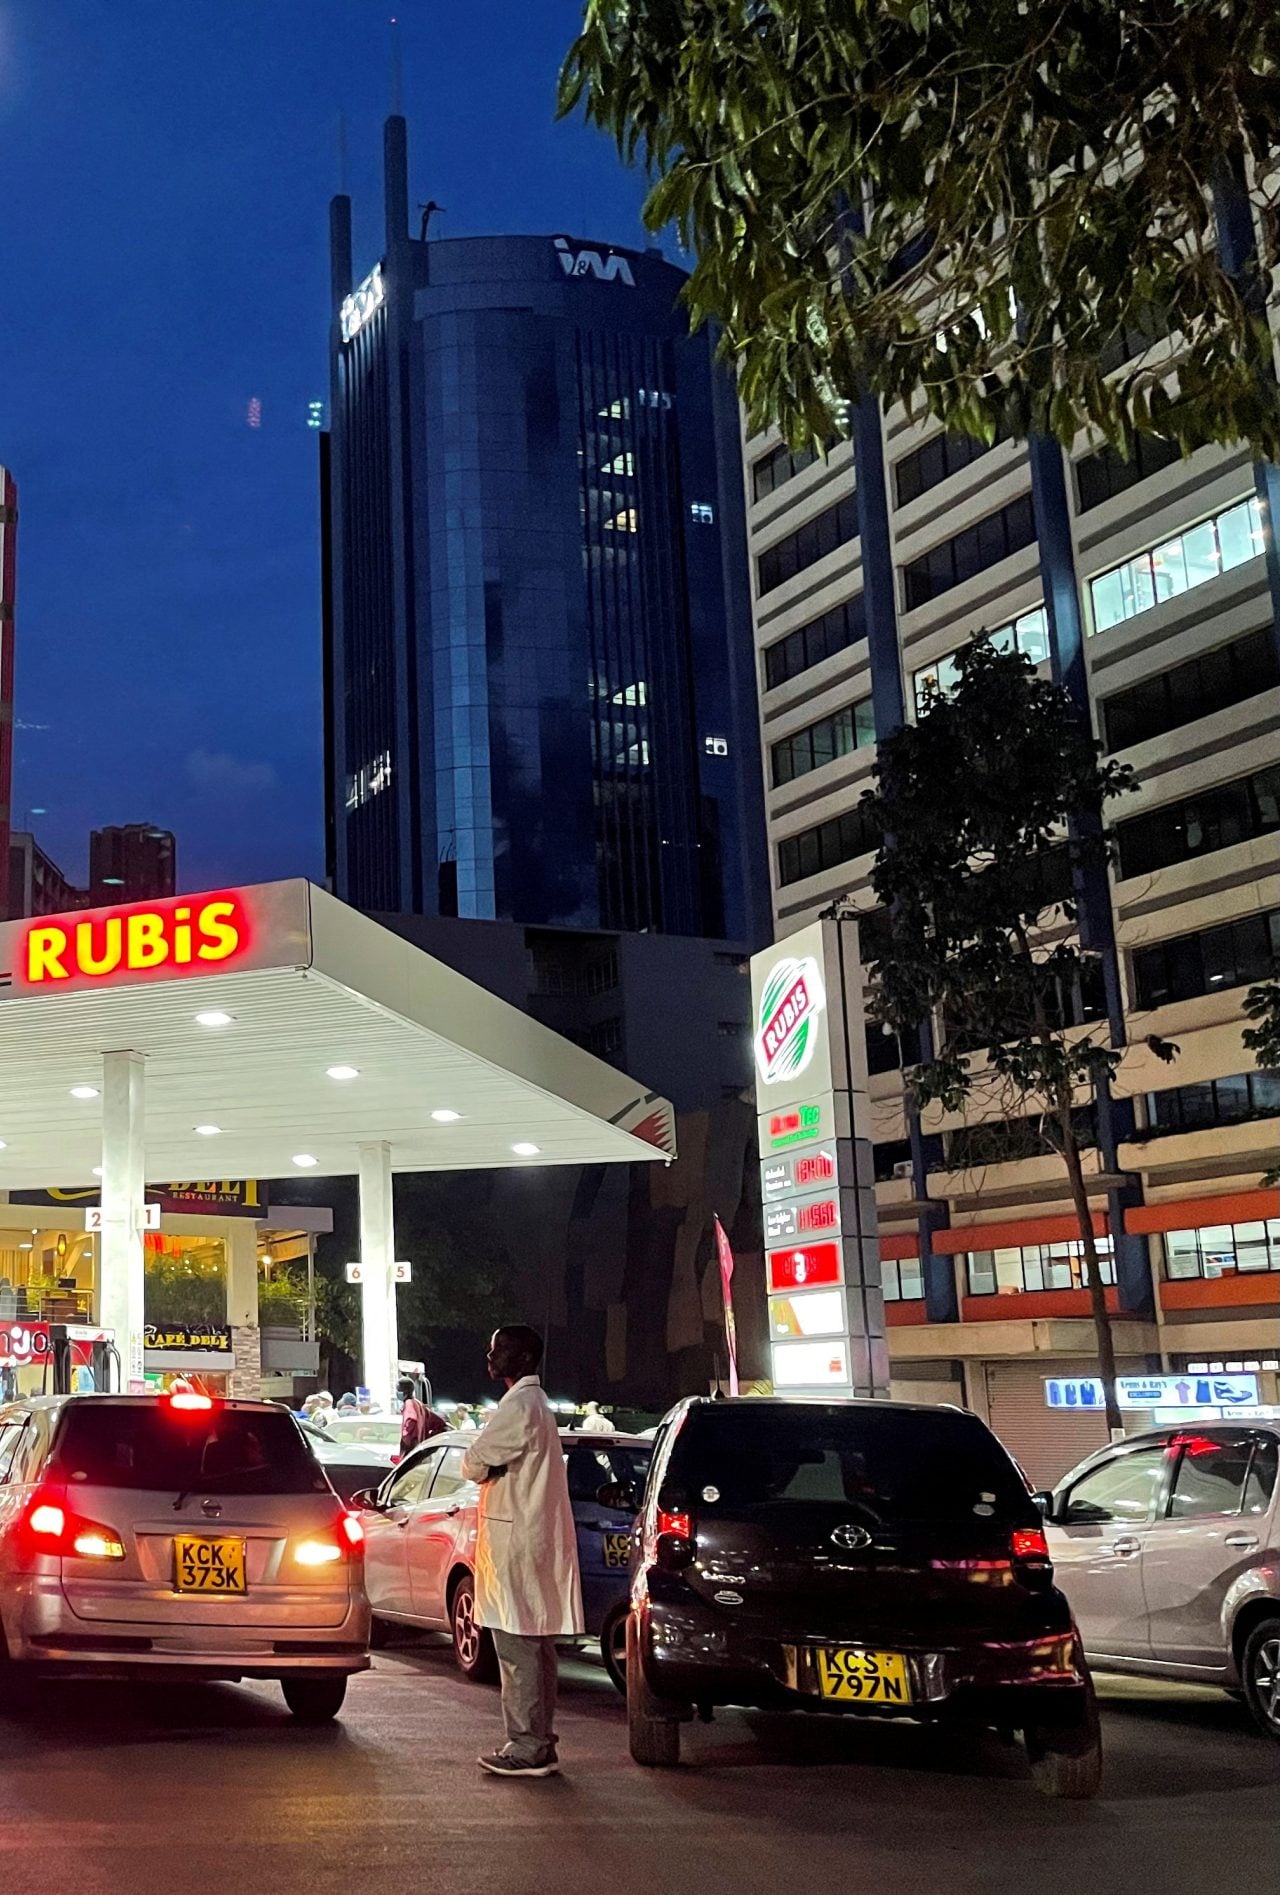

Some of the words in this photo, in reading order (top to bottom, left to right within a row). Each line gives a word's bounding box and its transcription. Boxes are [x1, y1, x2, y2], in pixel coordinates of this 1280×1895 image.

[765, 984, 807, 1056] RUBIS
[172, 1190, 239, 1203] RESTAURANT
[91, 1211, 102, 1227] 2
[145, 1208, 152, 1225] 1
[351, 1267, 361, 1279] 6
[396, 1266, 405, 1278] 5
[182, 1543, 225, 1566] KCK
[182, 1565, 240, 1588] 373K
[824, 1649, 879, 1675] KCS
[827, 1673, 902, 1699] 797N
